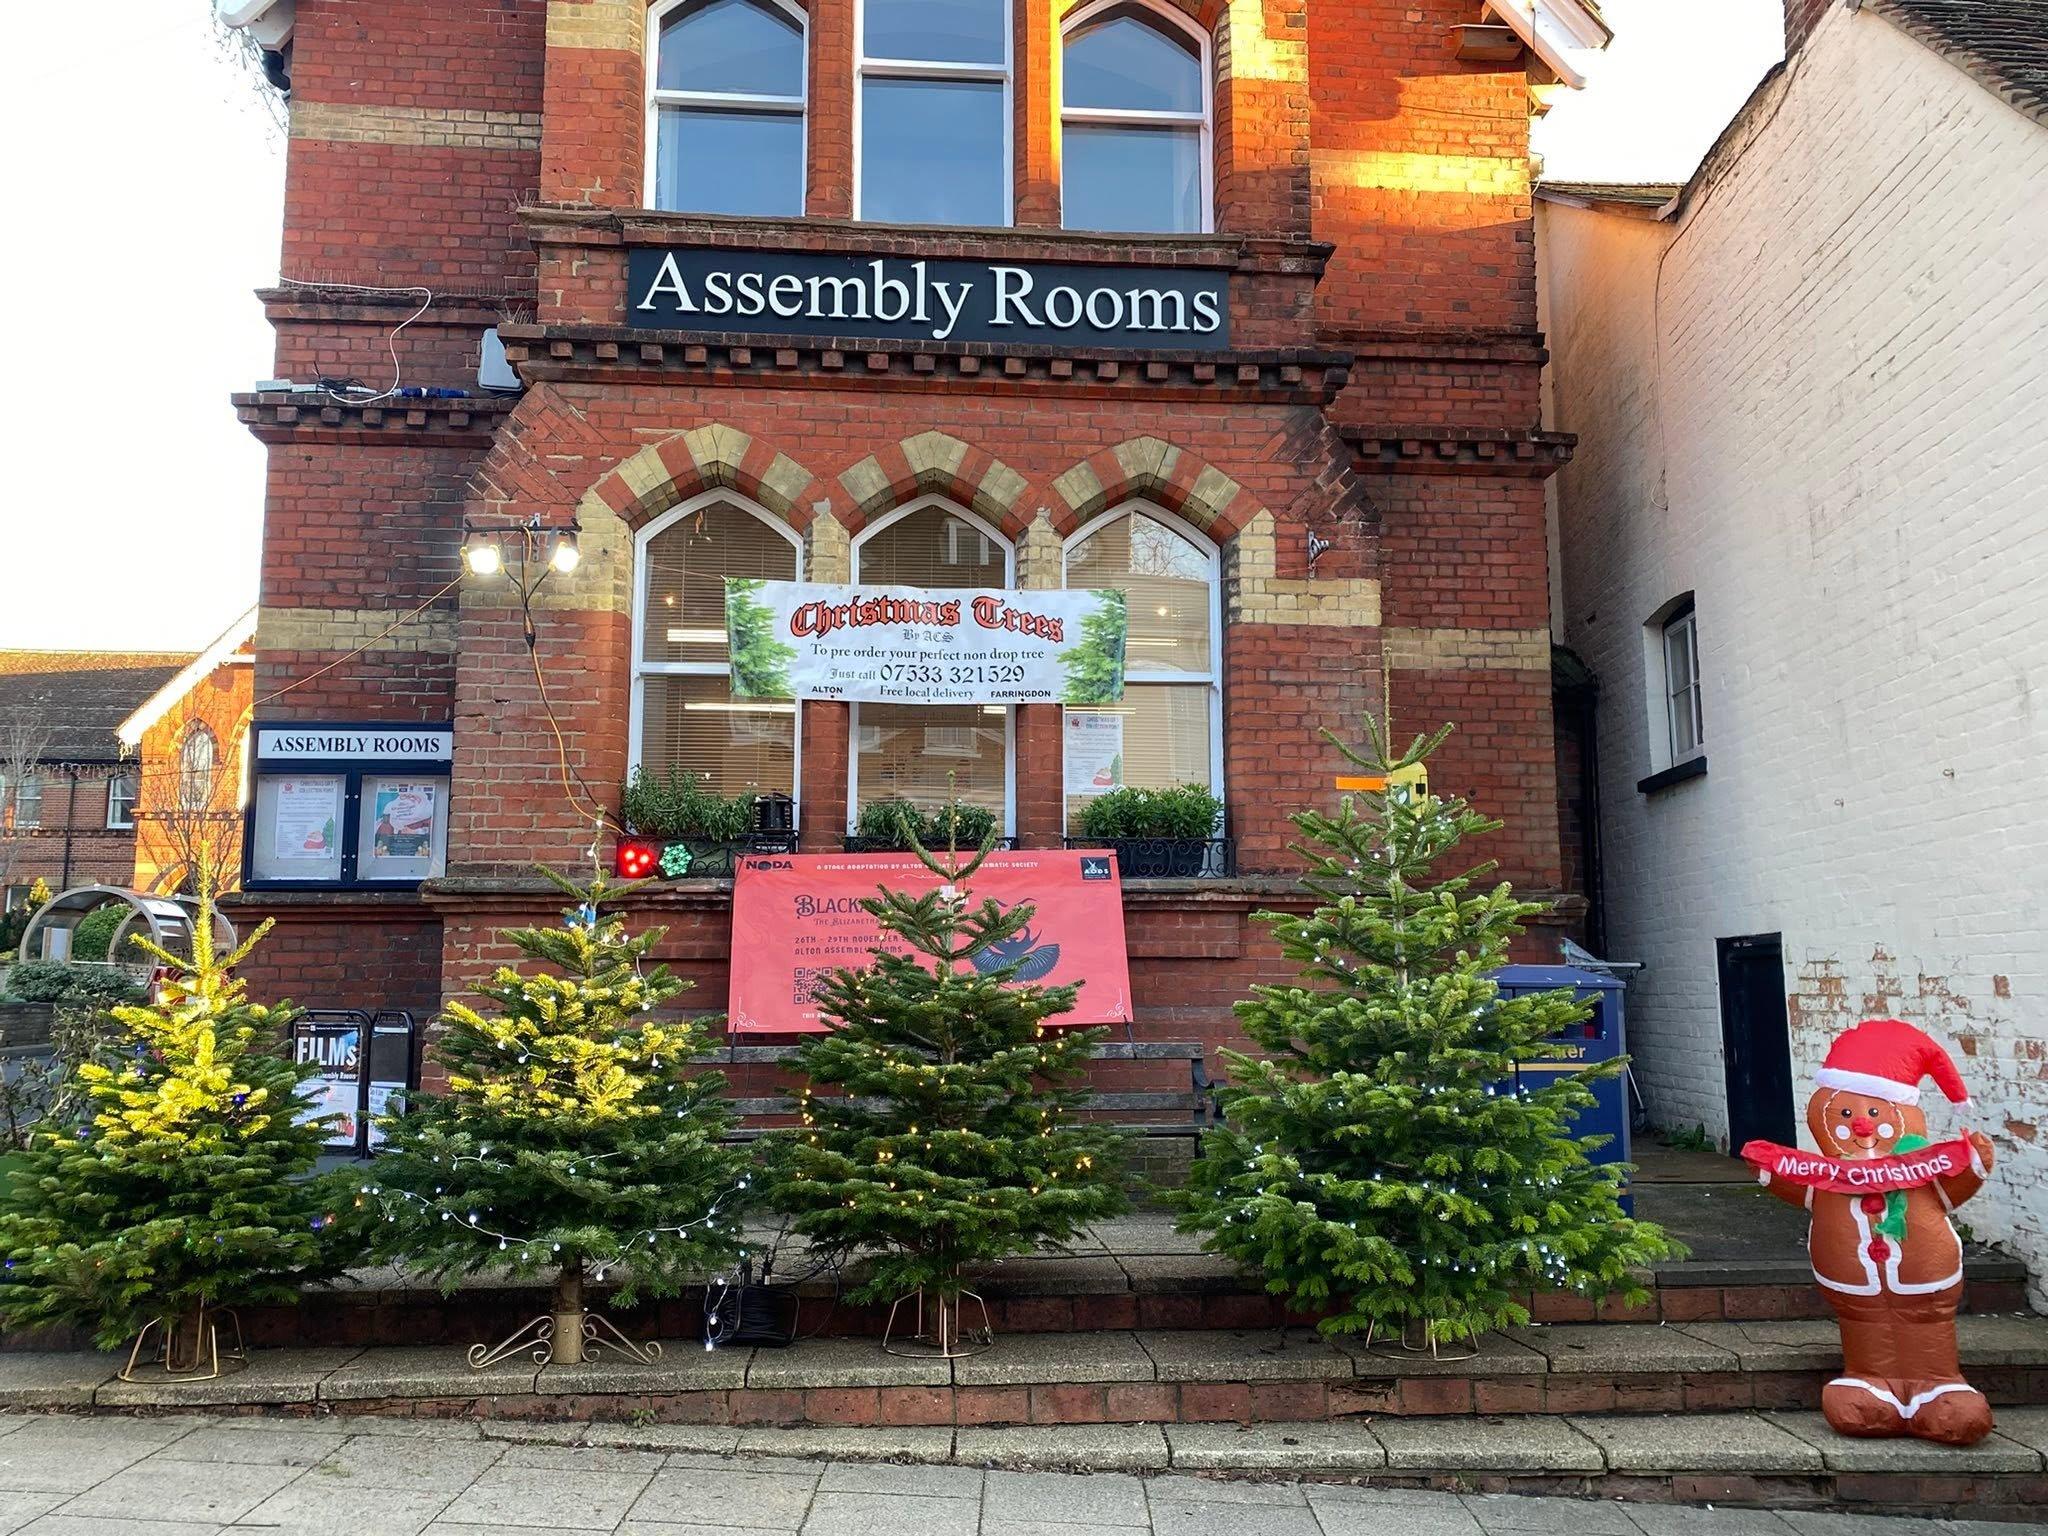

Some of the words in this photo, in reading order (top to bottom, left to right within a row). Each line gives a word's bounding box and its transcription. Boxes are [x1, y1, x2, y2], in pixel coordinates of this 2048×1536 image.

[636, 252, 973, 339] Assembly
[988, 266, 1221, 333] Rooms
[790, 594, 962, 639] Christmas
[971, 595, 1064, 643] Trees
[903, 628, 919, 641] By
[810, 643, 828, 655] To
[831, 648, 850, 659] pre
[854, 646, 886, 657] order
[889, 650, 917, 661] your
[920, 649, 960, 661] perfect
[964, 652, 986, 660] non
[990, 648, 1018, 661] drop
[1021, 650, 1044, 659] tree
[830, 668, 855, 680] Just
[859, 671, 876, 680] call
[880, 664, 942, 683] 07533
[949, 665, 1025, 683] 321529
[811, 686, 843, 694] ALTON
[880, 685, 903, 696] Free
[905, 686, 930, 697] local
[932, 688, 974, 700] delivery
[990, 690, 1051, 698] FARRINGDON
[272, 736, 369, 752] ASSEMBLY
[374, 737, 440, 753] ROOMS
[746, 860, 793, 871] NODA
[795, 936, 816, 944] 26TH
[1777, 1155, 1841, 1181] Merry
[1847, 1153, 1953, 1186] Christmas
